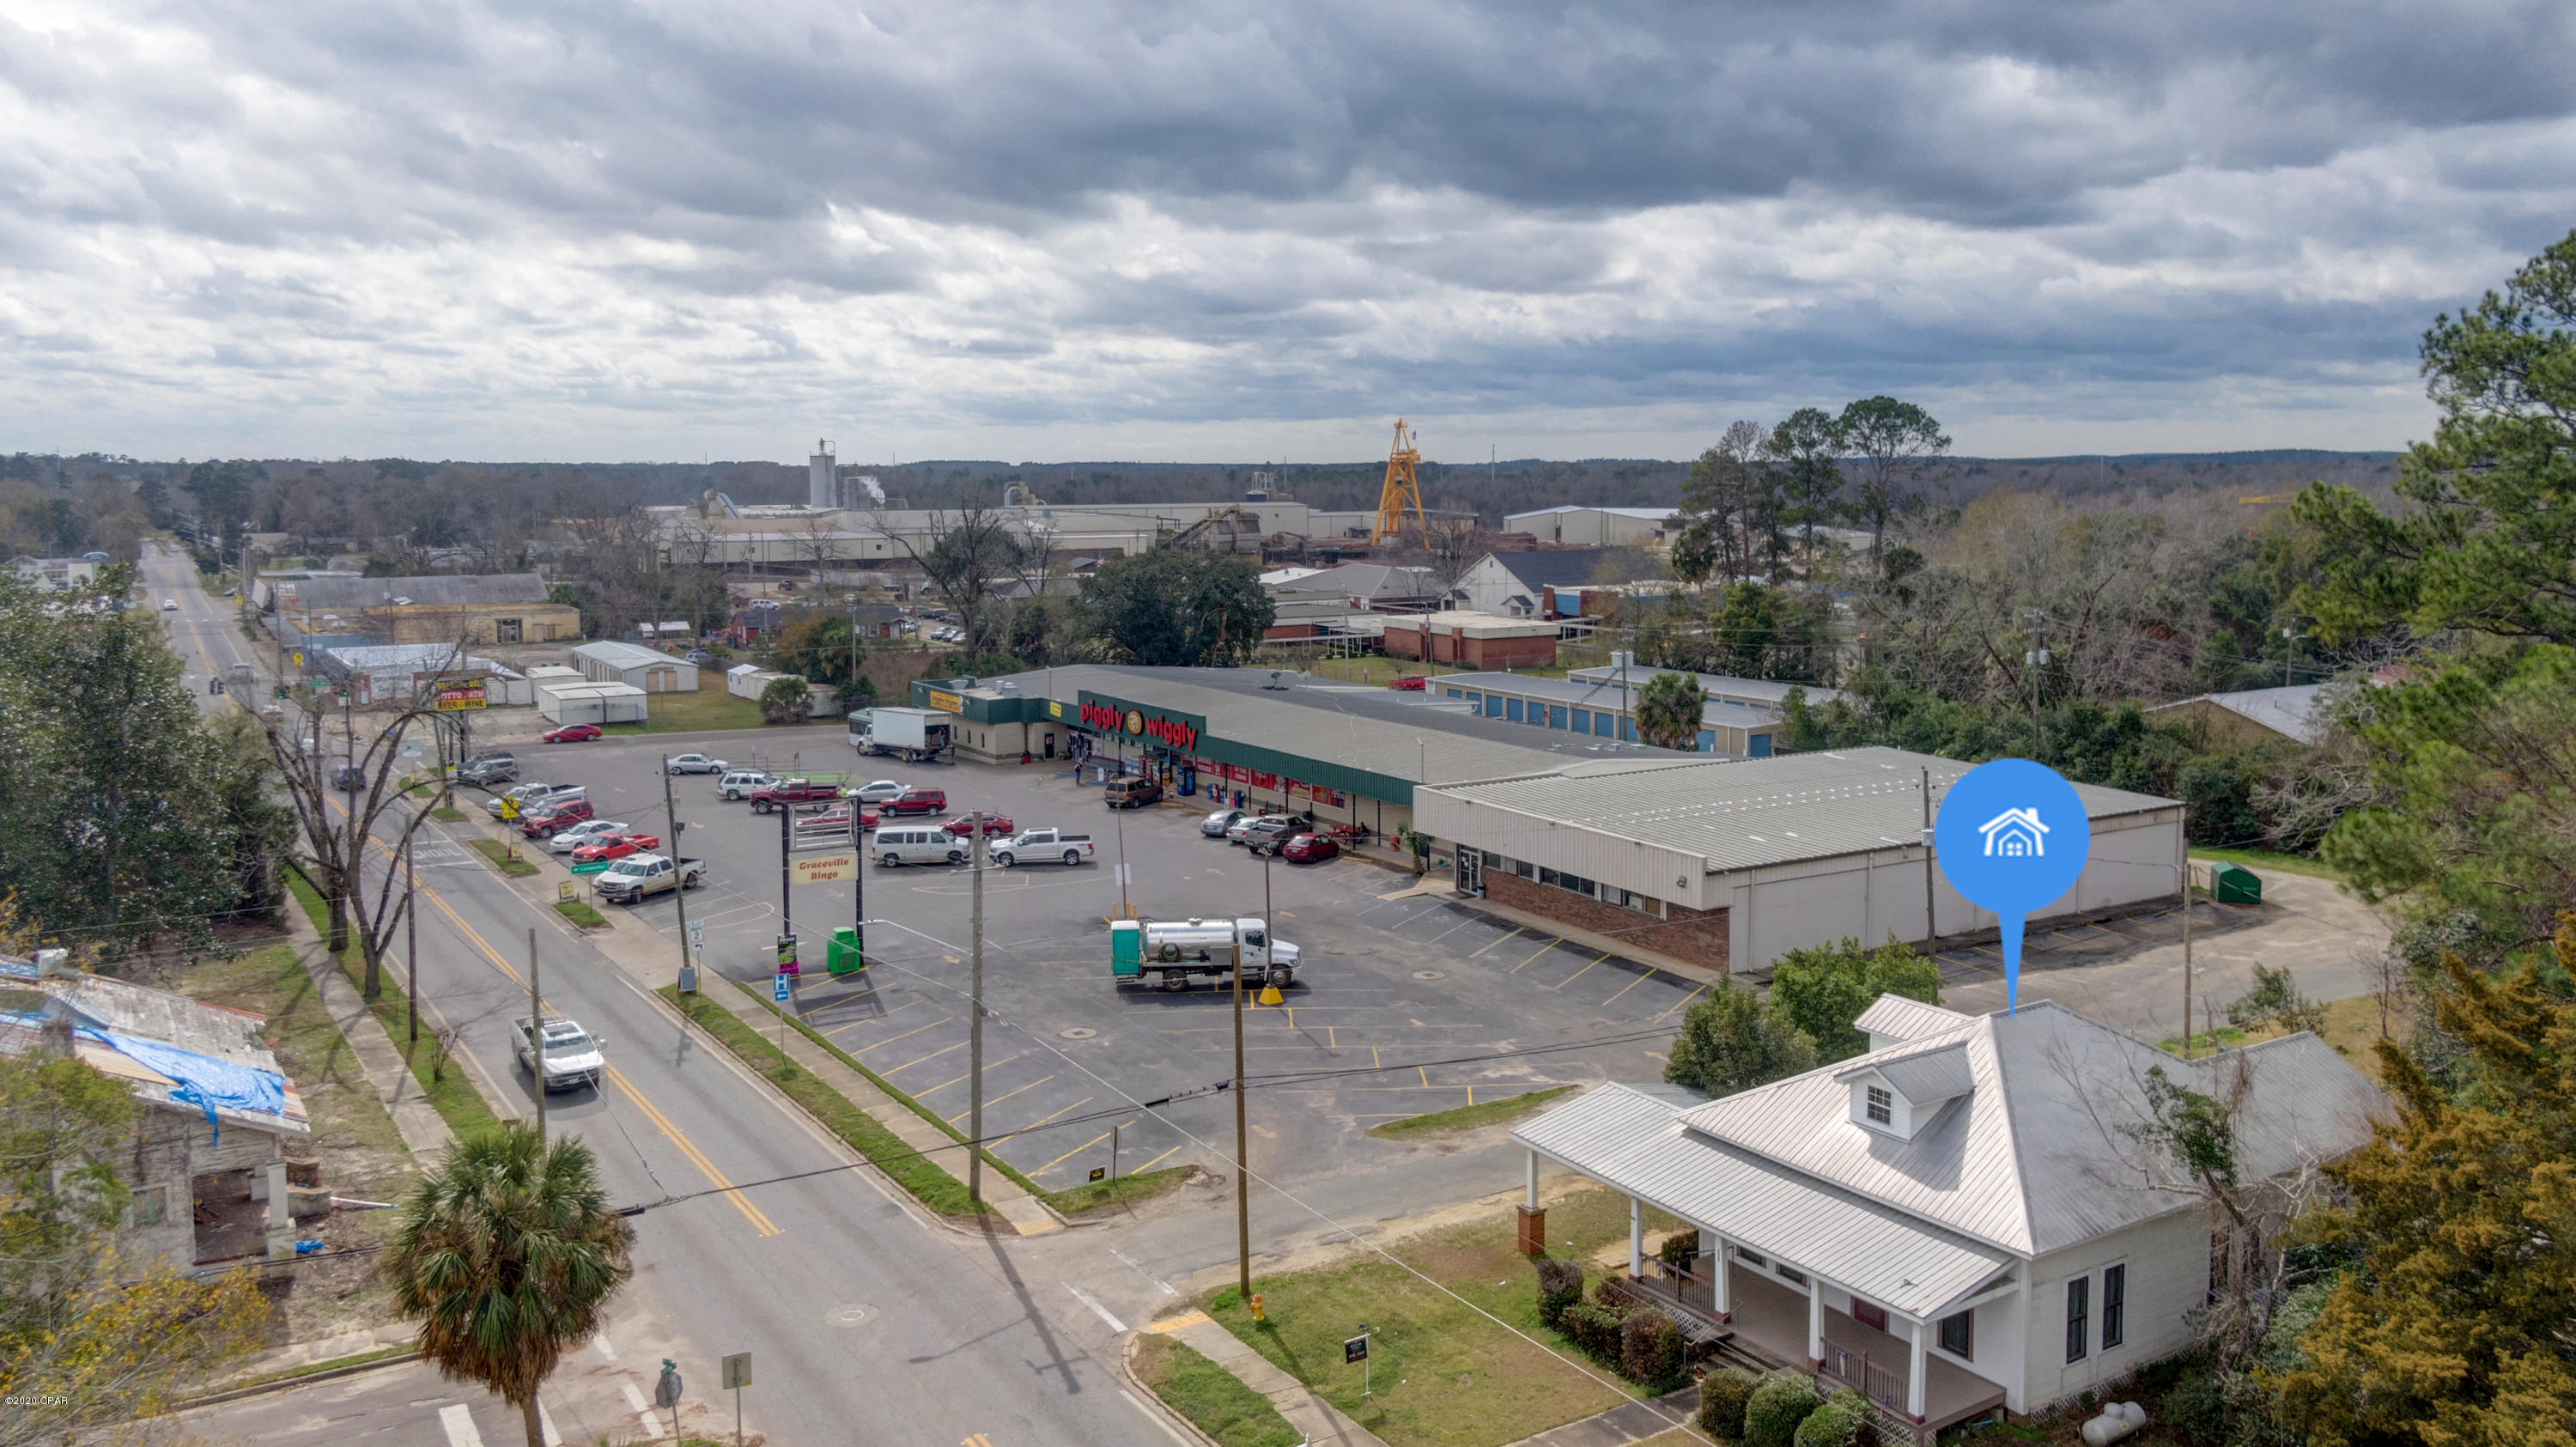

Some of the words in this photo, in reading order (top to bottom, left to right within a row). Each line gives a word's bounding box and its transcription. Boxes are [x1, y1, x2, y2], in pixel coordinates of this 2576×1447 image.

[465, 699, 484, 708] WINE
[1080, 699, 1124, 733] piggly
[1145, 714, 1196, 751] wiggly
[799, 858, 849, 870] Graceville
[811, 872, 838, 880] Bingo
[775, 976, 787, 990] H
